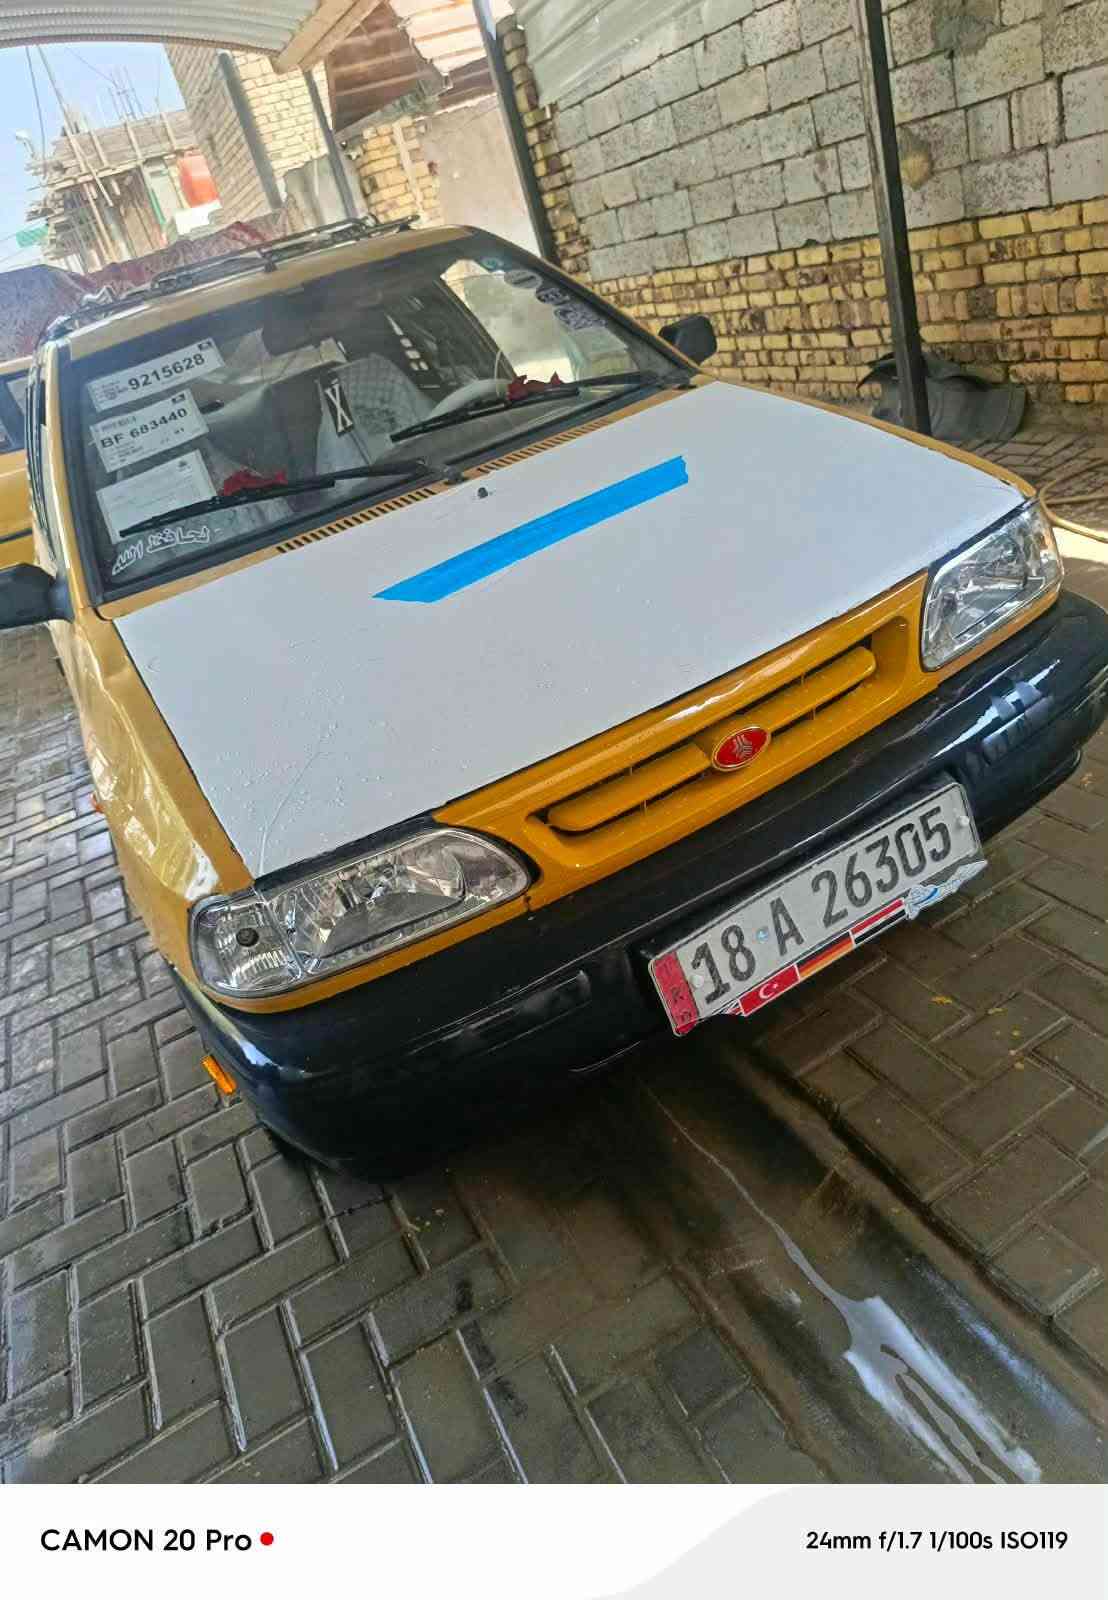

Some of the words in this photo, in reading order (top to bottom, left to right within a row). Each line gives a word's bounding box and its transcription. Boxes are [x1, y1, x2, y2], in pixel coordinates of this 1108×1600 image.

[128, 353, 205, 391] 9215628
[100, 432, 125, 449] BF
[129, 407, 187, 438] 683440
[691, 925, 756, 1004] 18
[769, 897, 804, 956] A
[811, 806, 951, 928] 26305
